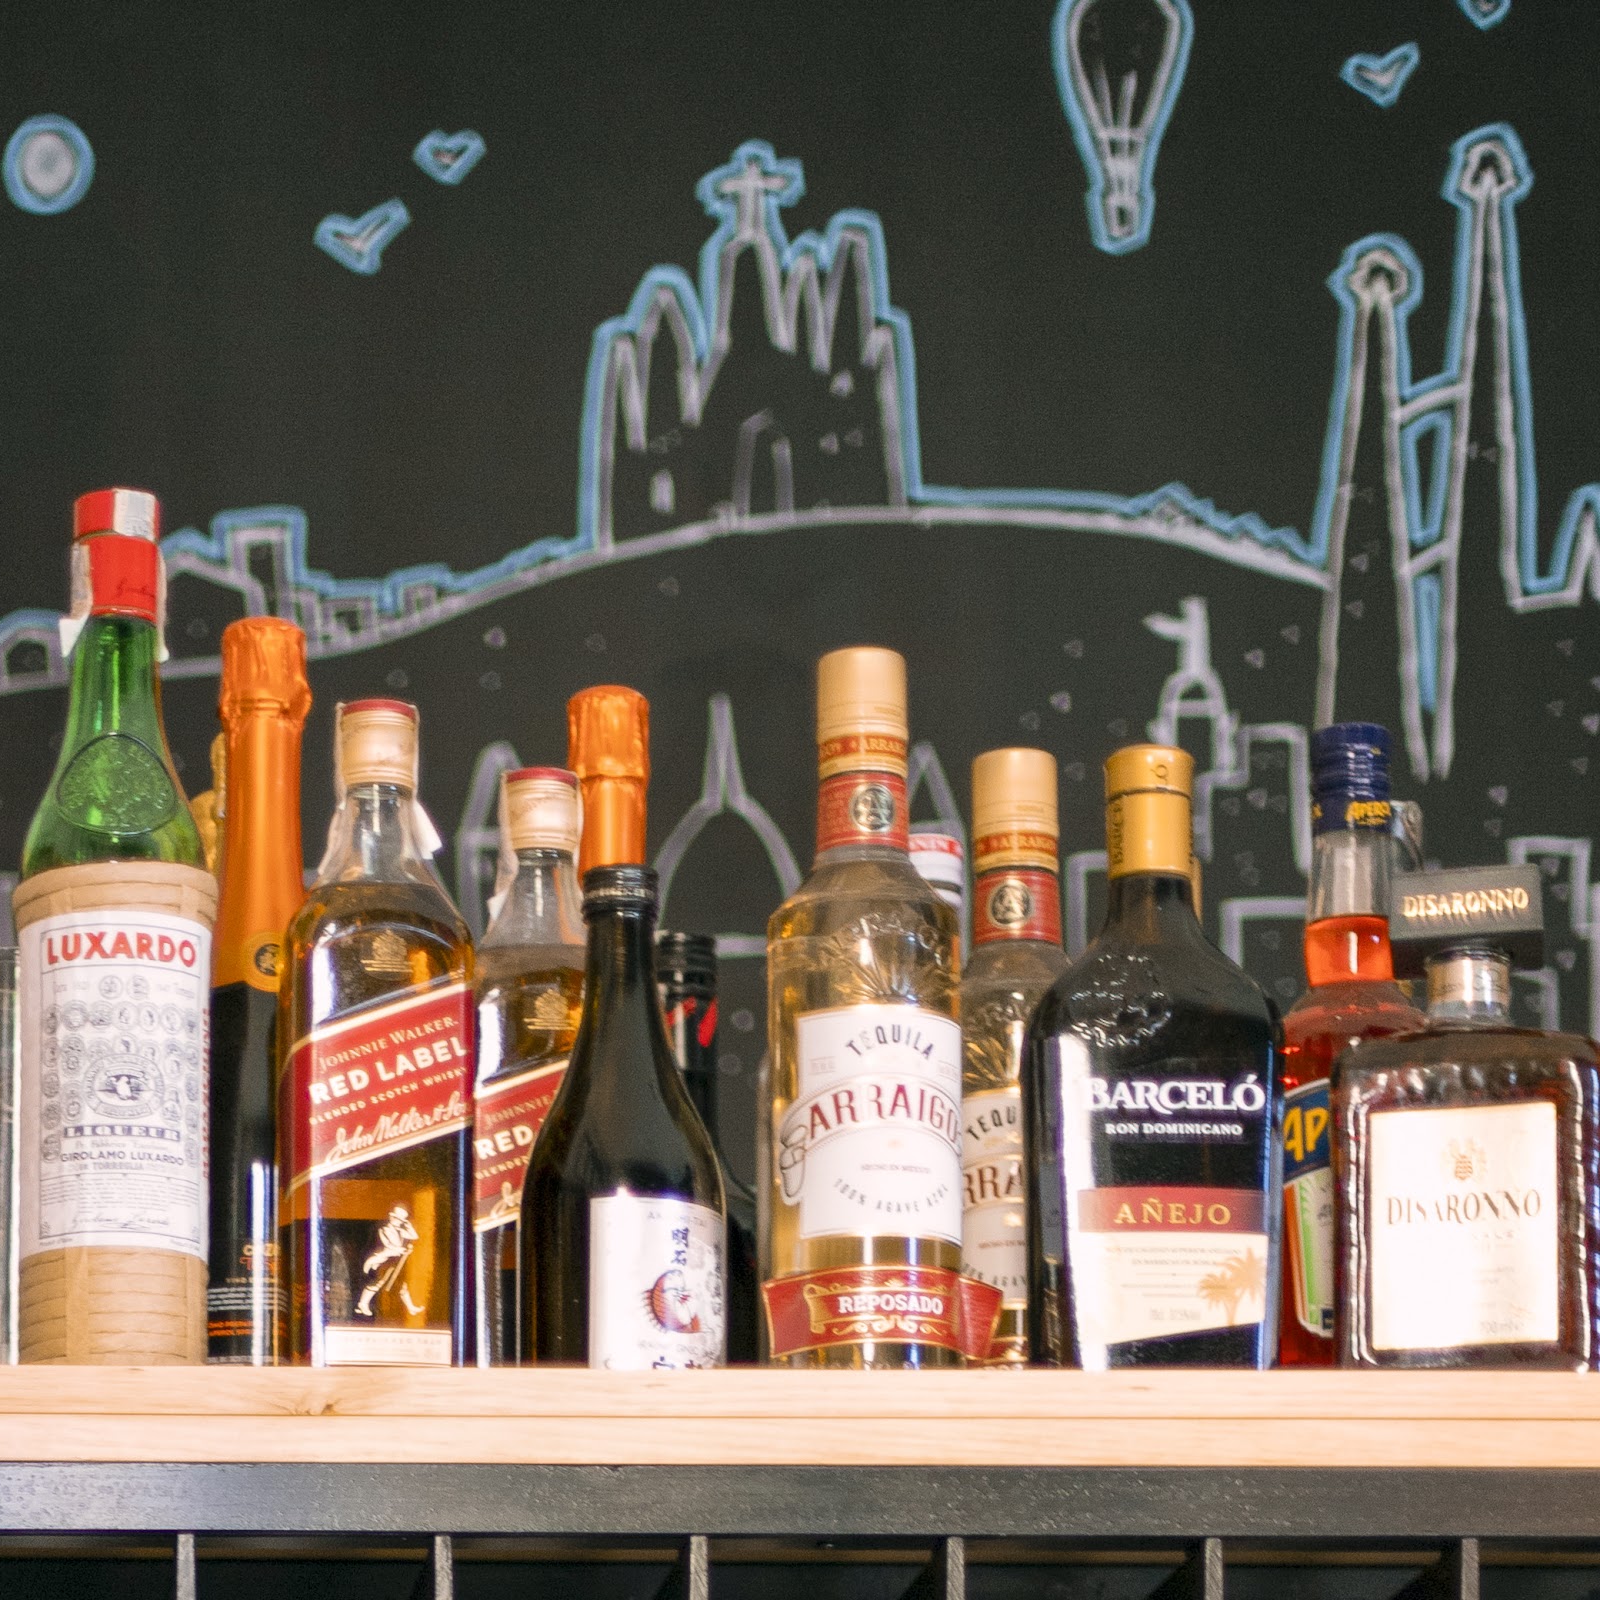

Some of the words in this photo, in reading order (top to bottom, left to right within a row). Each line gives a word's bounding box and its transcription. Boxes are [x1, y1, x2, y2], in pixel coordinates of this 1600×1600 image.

[1403, 887, 1529, 918] DISARONNO
[47, 931, 196, 967] LUXARDO
[319, 1038, 389, 1074] JOHNNIE
[846, 1024, 934, 1060] TEQUILA
[308, 1069, 370, 1105] RED
[375, 1037, 467, 1081] LABEL
[309, 1100, 366, 1125] BLENDED
[370, 1082, 419, 1104] SCOTCH
[1085, 1074, 1266, 1114] BARCELÓ
[809, 1084, 959, 1143] ARRAIGO
[1105, 1123, 1140, 1135] RON
[1143, 1123, 1243, 1136] DOMINICANO
[61, 1151, 126, 1162] GIROLAMO
[131, 1151, 184, 1166] LUXARDO
[474, 1124, 533, 1160] RED
[1114, 1197, 1232, 1225] AÑEJO
[1387, 1190, 1541, 1225] DISARONNO
[838, 1294, 943, 1315] REPOSADO
